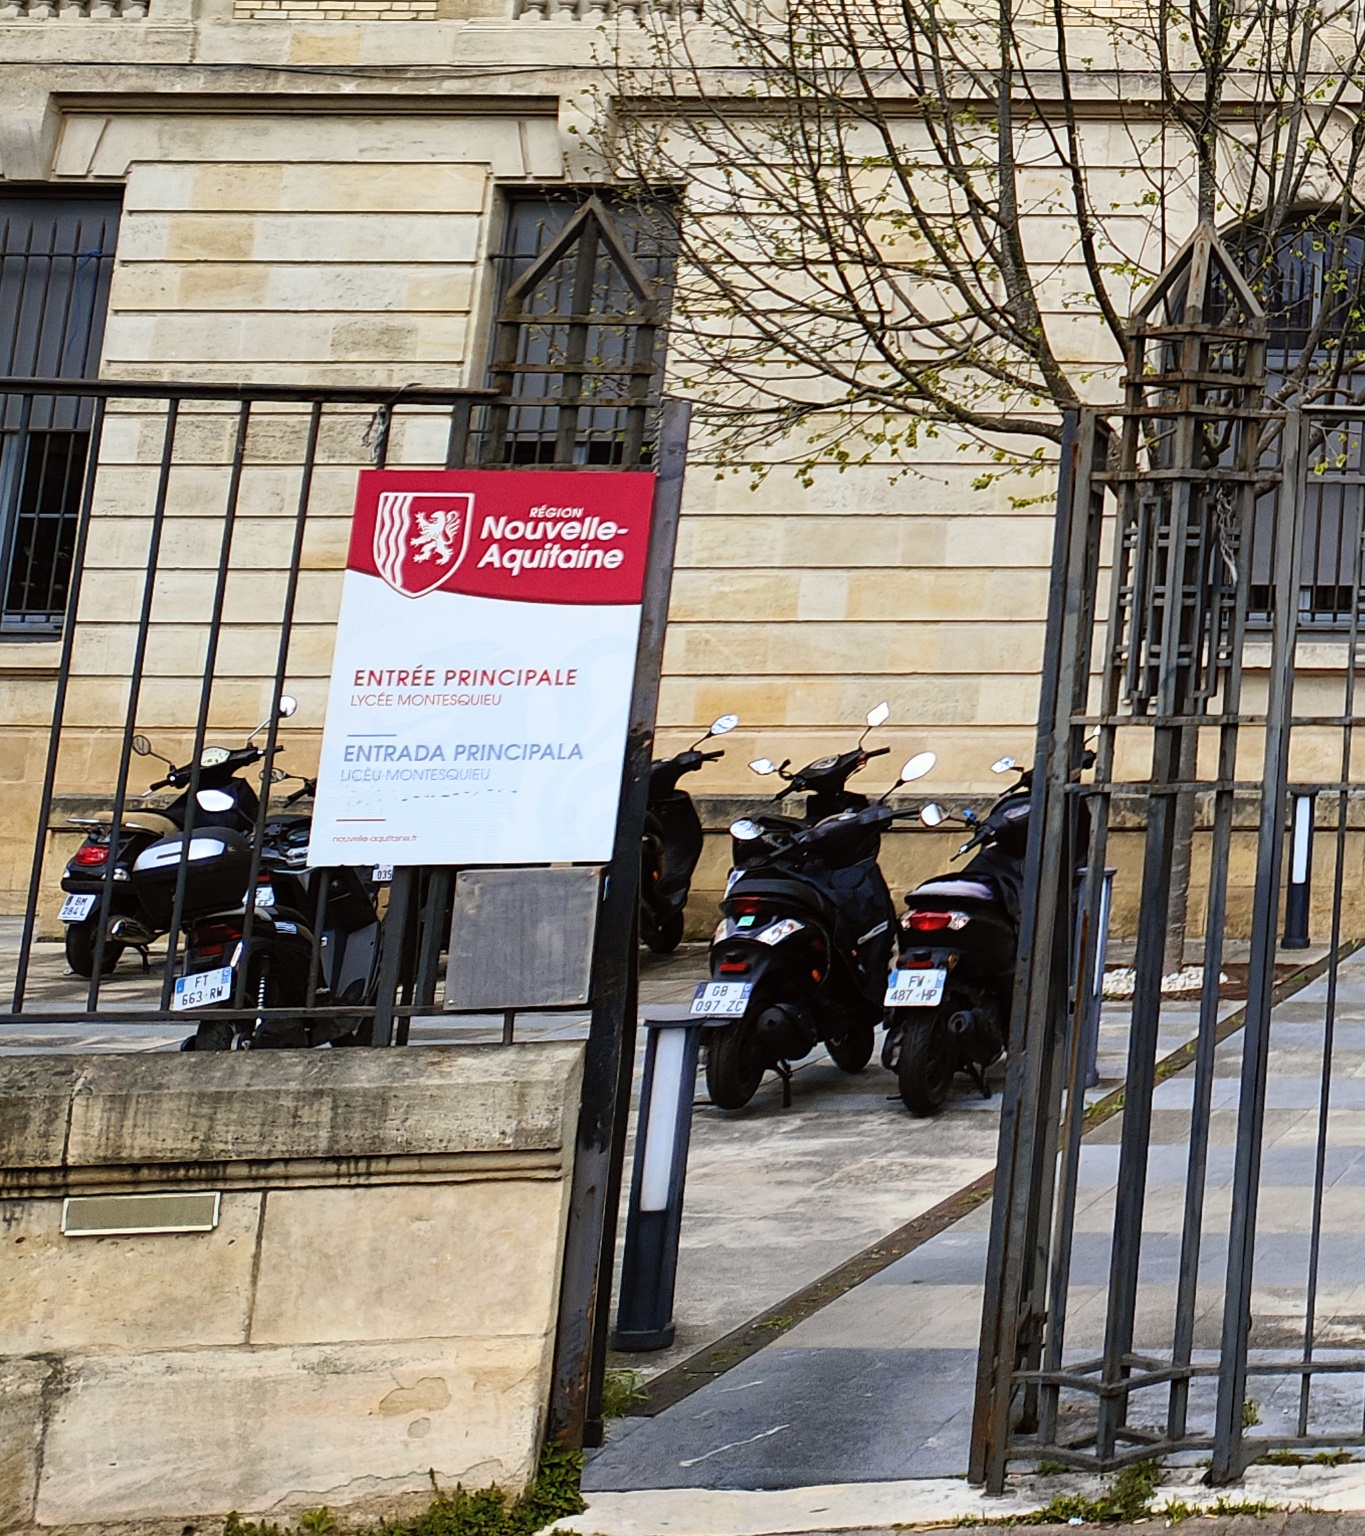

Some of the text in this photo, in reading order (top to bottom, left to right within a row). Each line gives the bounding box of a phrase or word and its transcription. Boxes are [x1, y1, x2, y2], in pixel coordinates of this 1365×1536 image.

[529, 504, 585, 519] RÉGION
[480, 515, 629, 541] Nouvelle-
[476, 542, 625, 577] Aquitaine
[353, 664, 578, 687] ENTRÉE PRINCIPALE
[350, 692, 502, 707] LYCÉE MONTESQUIEU
[343, 743, 584, 763] ENTRADA PRINCIPALA
[385, 768, 491, 781] MONTESQUIEU
